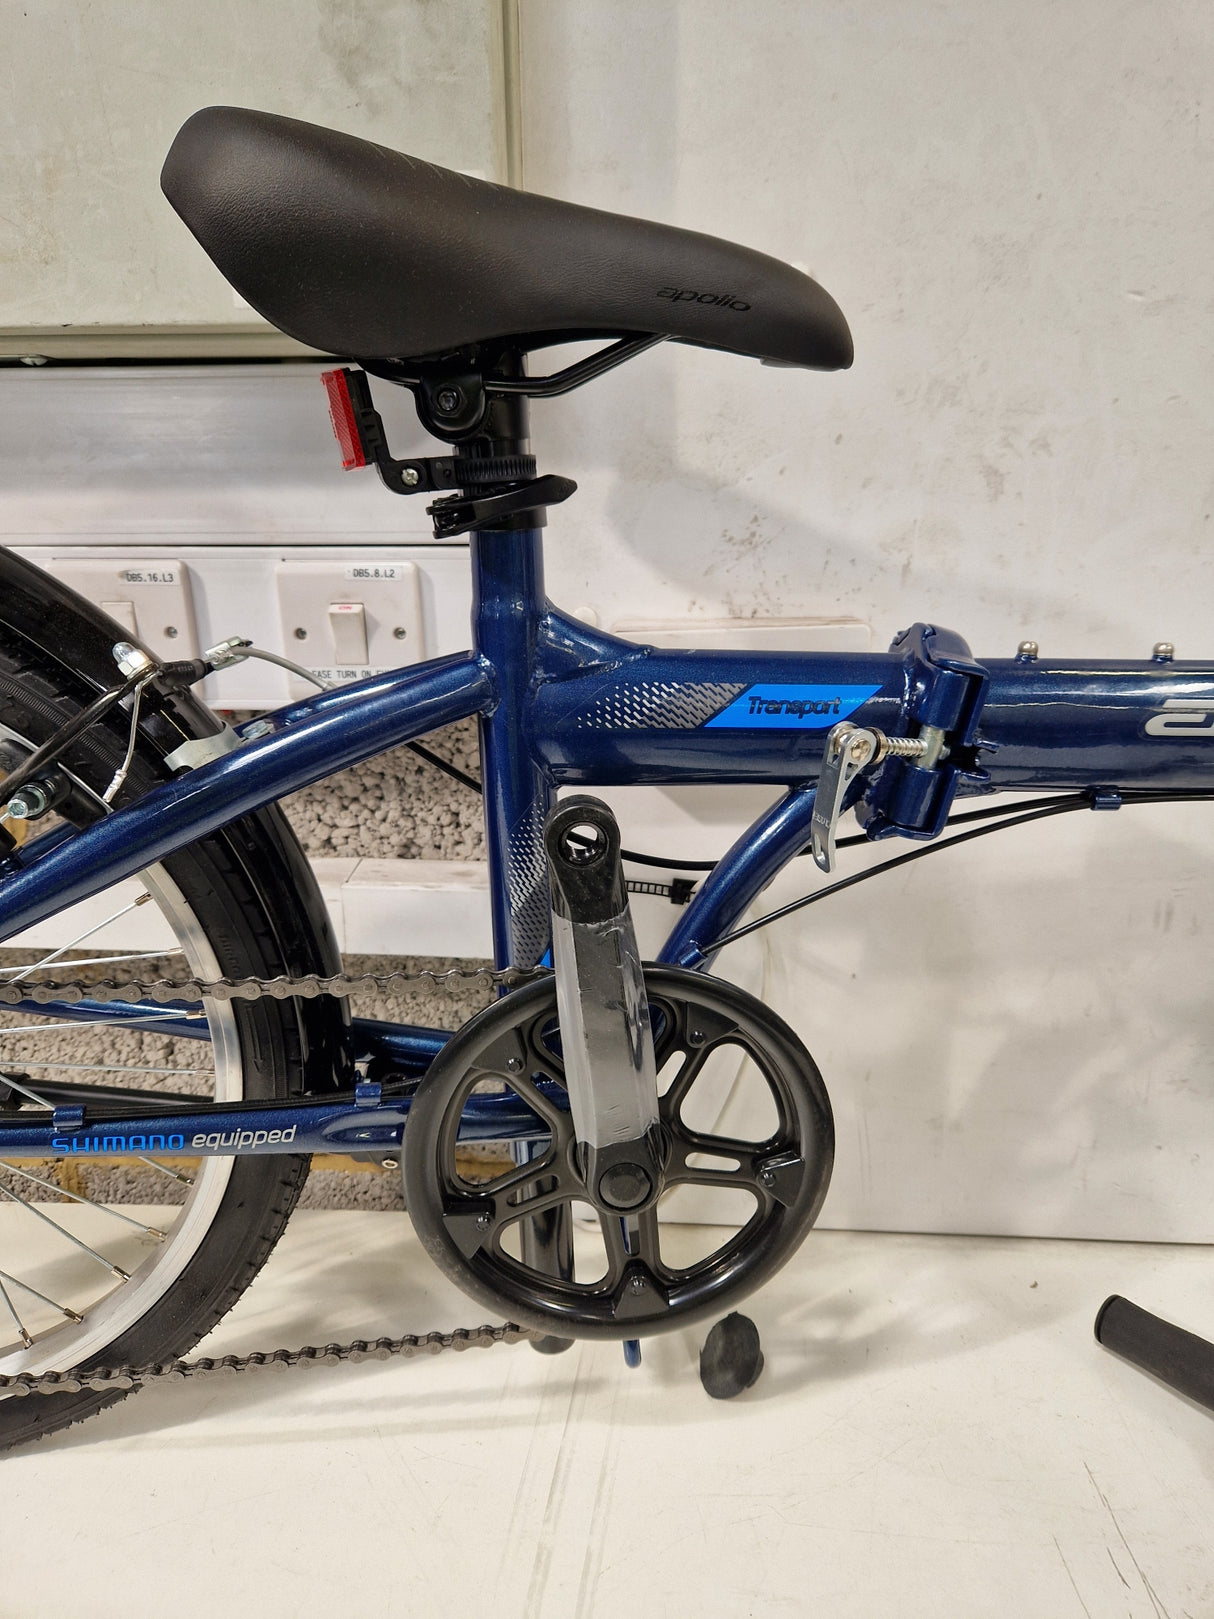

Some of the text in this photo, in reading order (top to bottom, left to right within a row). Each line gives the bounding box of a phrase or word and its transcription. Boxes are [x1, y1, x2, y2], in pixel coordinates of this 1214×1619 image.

[656, 287, 751, 311] apollo
[353, 568, 395, 578] DB5.8.L2
[337, 670, 357, 679] TURN
[361, 670, 372, 679] ON
[748, 696, 841, 719] Transport
[52, 1125, 297, 1153] SHIMANO equipped
